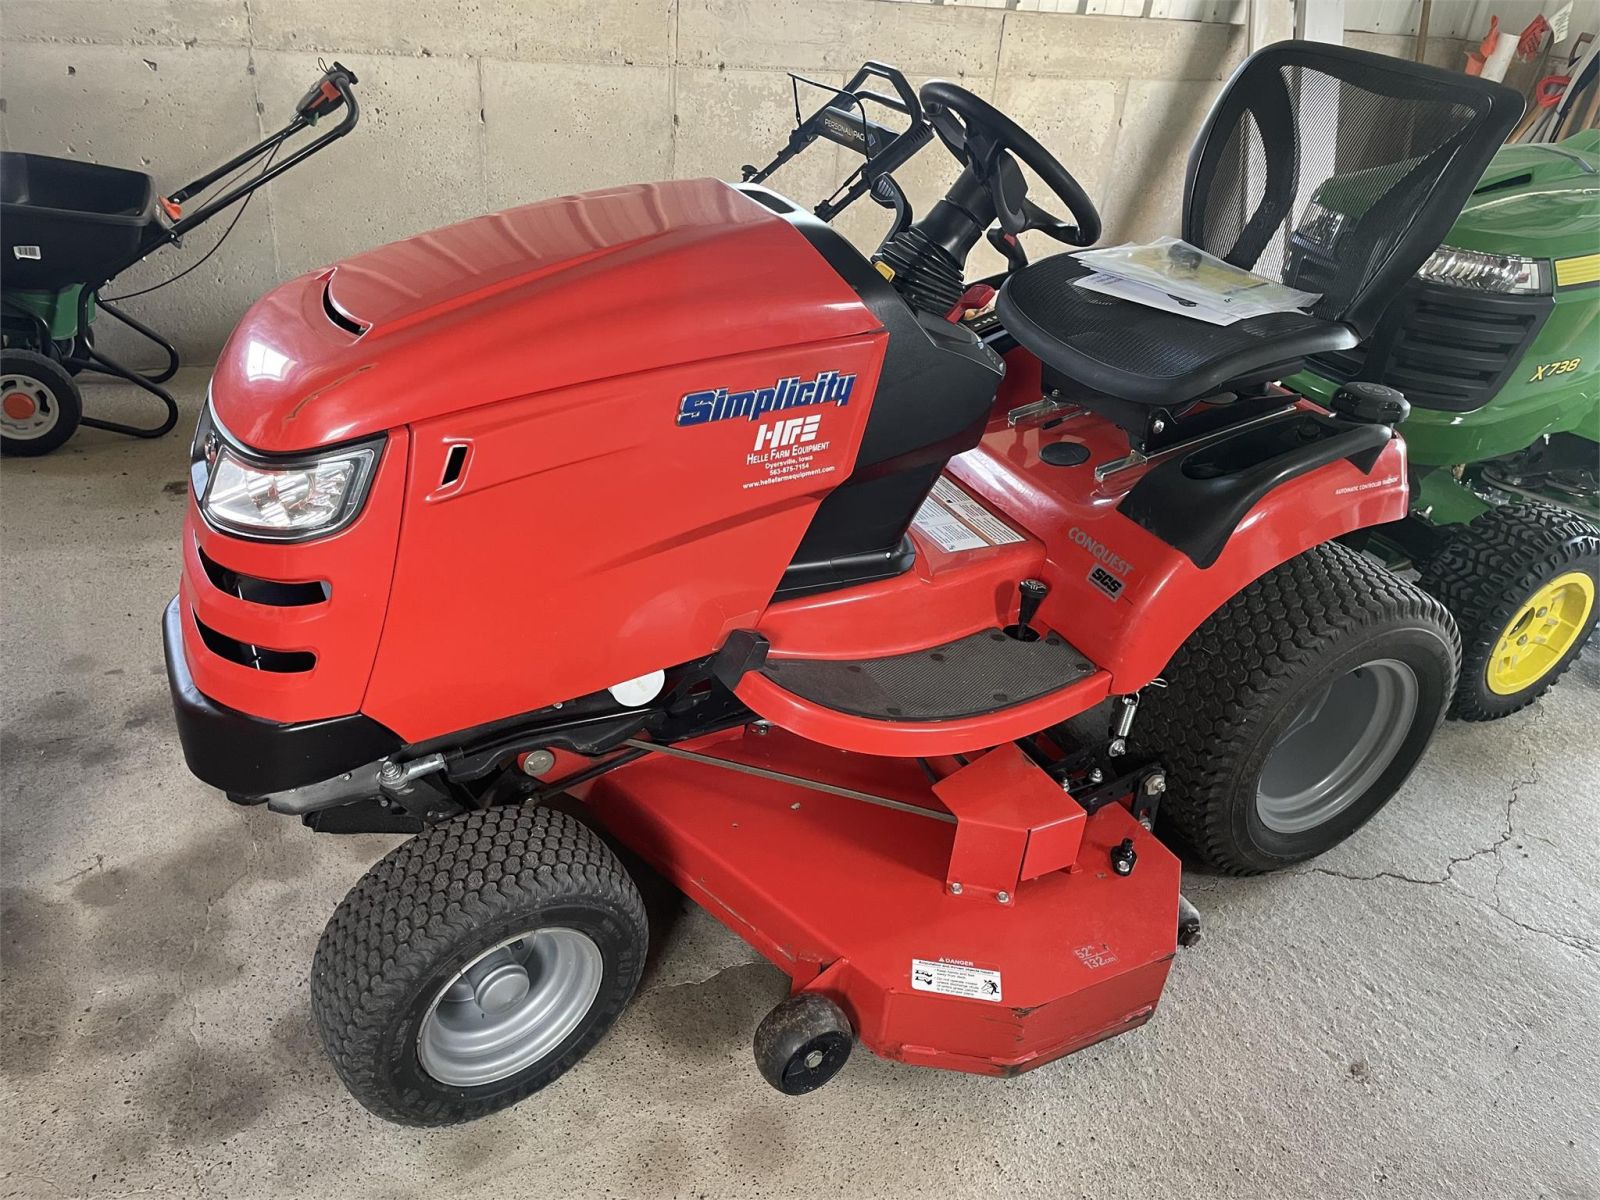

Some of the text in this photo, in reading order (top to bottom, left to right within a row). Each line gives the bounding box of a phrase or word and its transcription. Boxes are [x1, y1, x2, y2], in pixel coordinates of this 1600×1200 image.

[1528, 356, 1582, 383] X738
[676, 370, 857, 427] Simplicity
[1068, 526, 1134, 577] CONQUEST
[1091, 567, 1123, 593] SCS
[945, 958, 974, 967] DANGER
